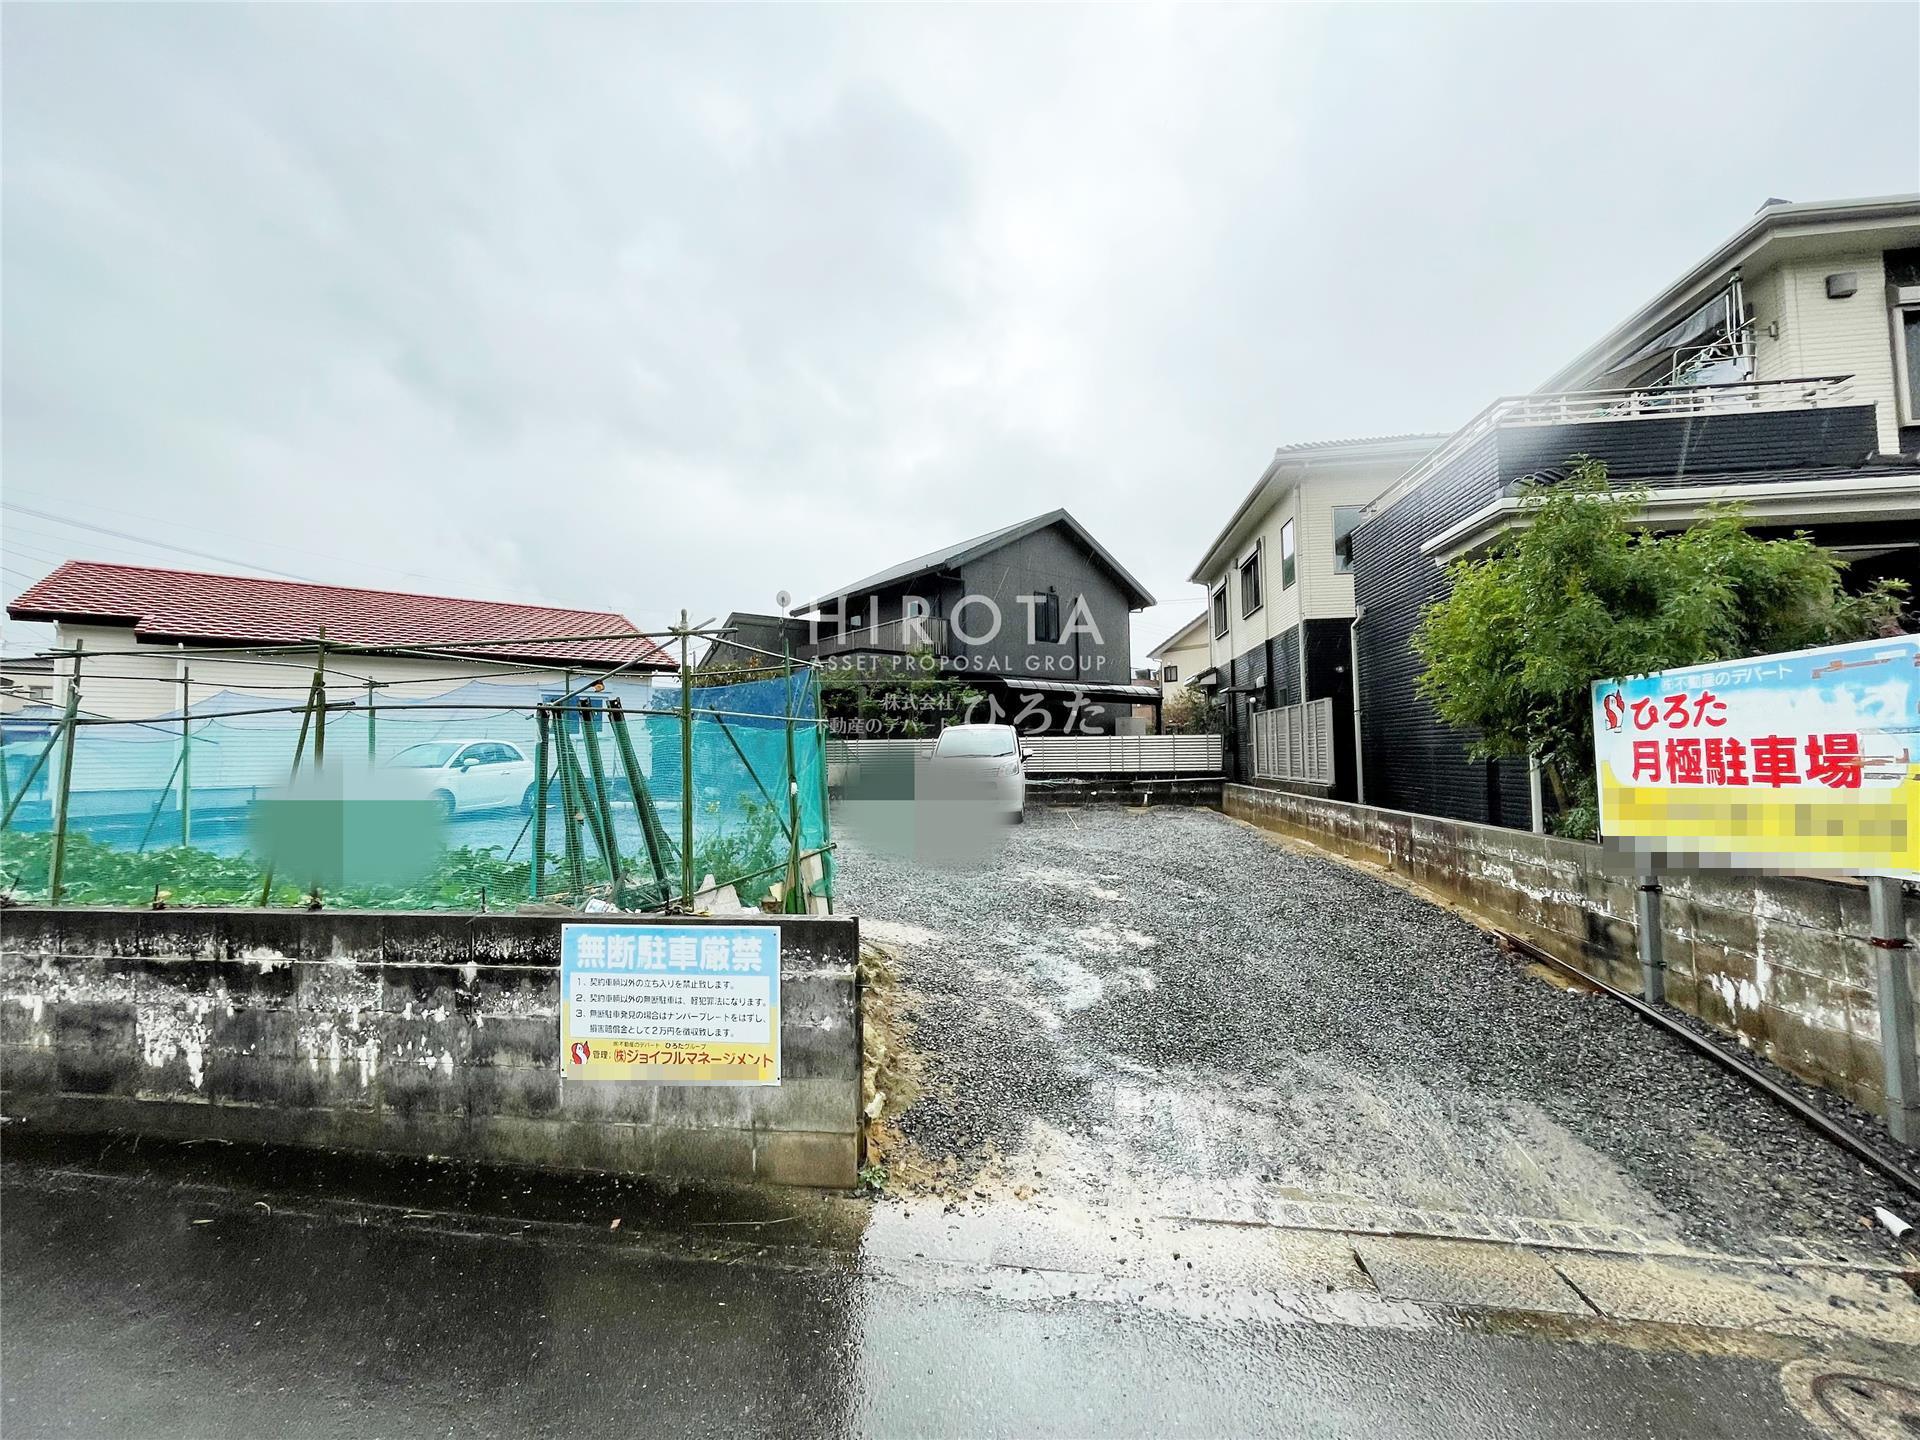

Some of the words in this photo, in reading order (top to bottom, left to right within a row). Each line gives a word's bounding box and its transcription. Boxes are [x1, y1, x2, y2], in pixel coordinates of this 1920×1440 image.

[1631, 690, 1727, 730] ひろた
[1632, 733, 1862, 788] 月極駐車場
[576, 934, 763, 971] 無断駐車厳禁
